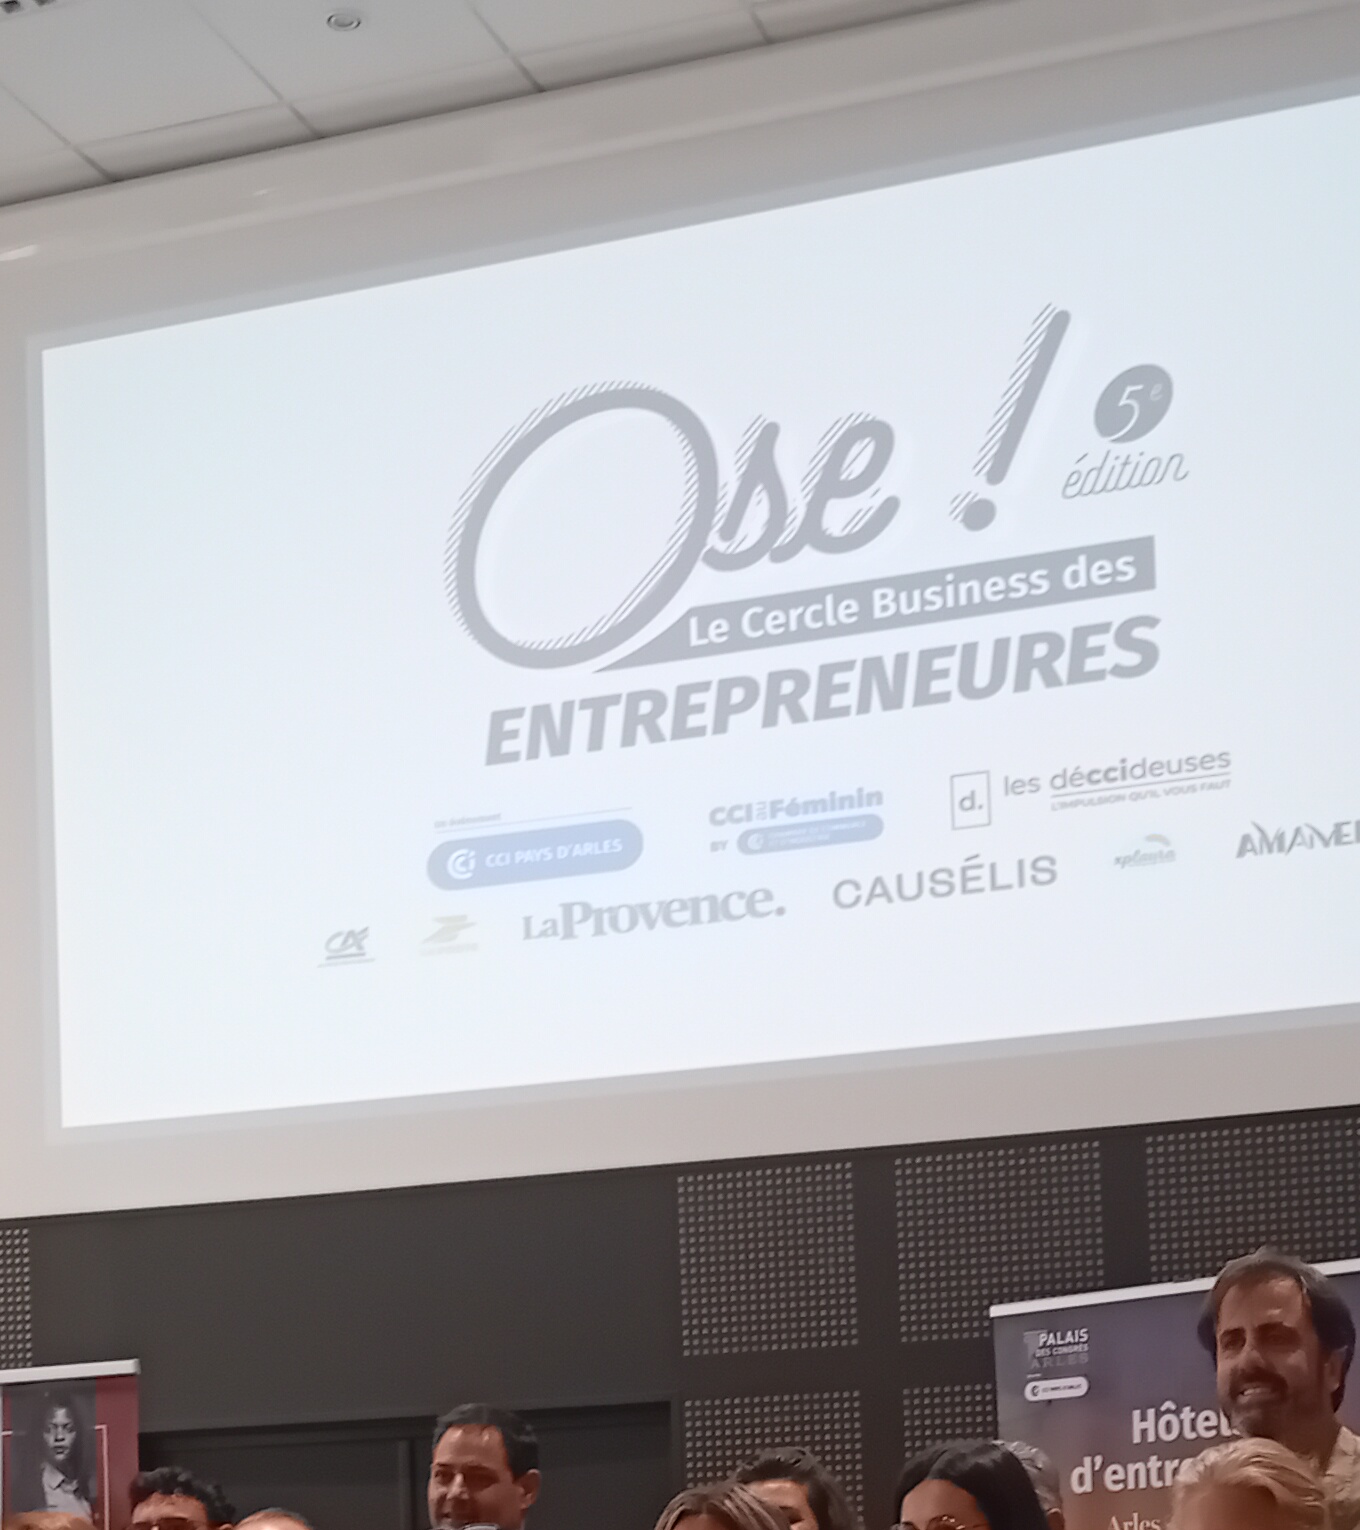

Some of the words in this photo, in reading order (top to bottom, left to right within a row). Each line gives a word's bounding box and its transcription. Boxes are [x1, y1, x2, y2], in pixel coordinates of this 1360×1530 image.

[444, 381, 901, 670] Ose
[950, 303, 1071, 532] !
[1061, 449, 1190, 500] édition
[688, 613, 730, 648] Le
[740, 593, 860, 640] Cercle
[872, 567, 1051, 621] Business
[1061, 553, 1137, 590] des
[484, 614, 1162, 767] ENTREPRENEURES
[1003, 775, 1041, 797] les
[1049, 751, 1232, 791] déccideuses
[708, 804, 753, 827] CCI
[769, 786, 884, 820] Féminin
[485, 852, 511, 868] CCI
[514, 846, 554, 865] PAYS
[556, 838, 624, 860] D'ARLES
[832, 854, 1058, 910] CAUSÉLIS
[1039, 1327, 1089, 1347] PALAIS
[1131, 1400, 1241, 1444] Hôtel
